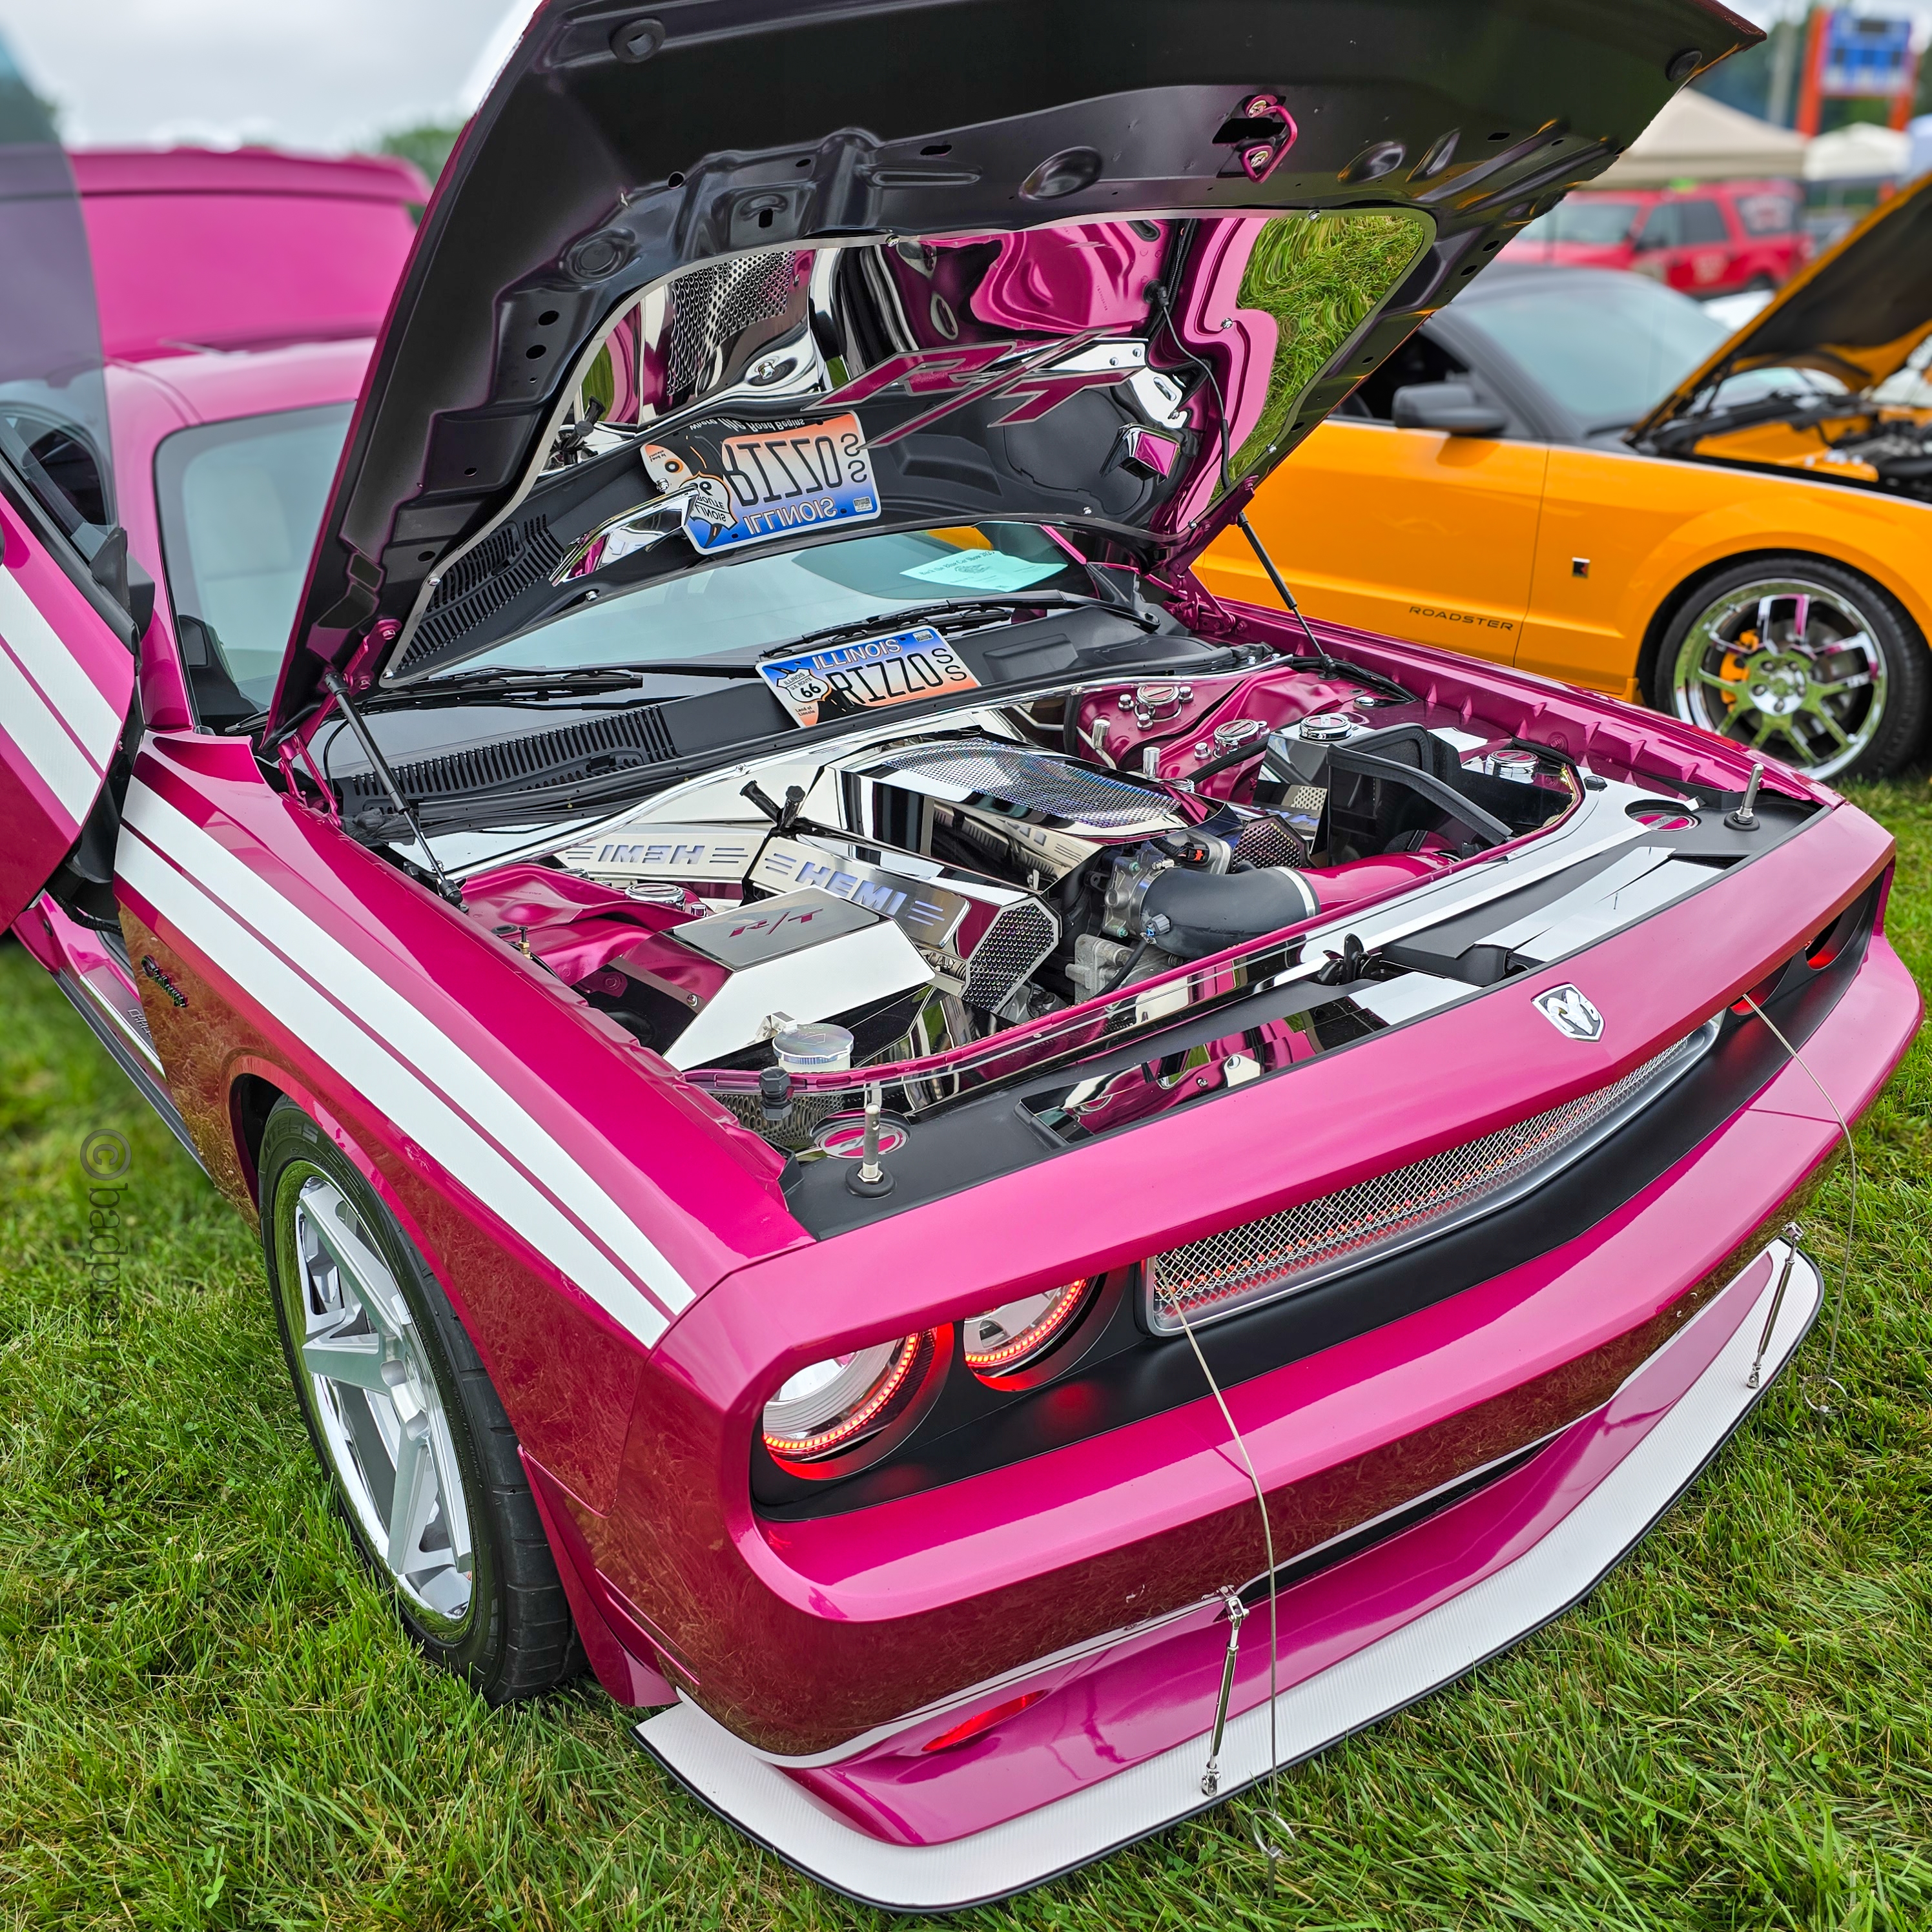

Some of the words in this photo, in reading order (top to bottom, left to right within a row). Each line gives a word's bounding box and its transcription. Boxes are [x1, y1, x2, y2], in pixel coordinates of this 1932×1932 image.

[1409, 606, 1514, 631] ROADSTER
[812, 639, 901, 670] ILLINOIS
[783, 672, 805, 684] ILLINOIS
[800, 683, 821, 698] 66
[824, 652, 944, 704] RIZZO
[795, 861, 907, 916] HEMI
[729, 909, 823, 938] R/T
